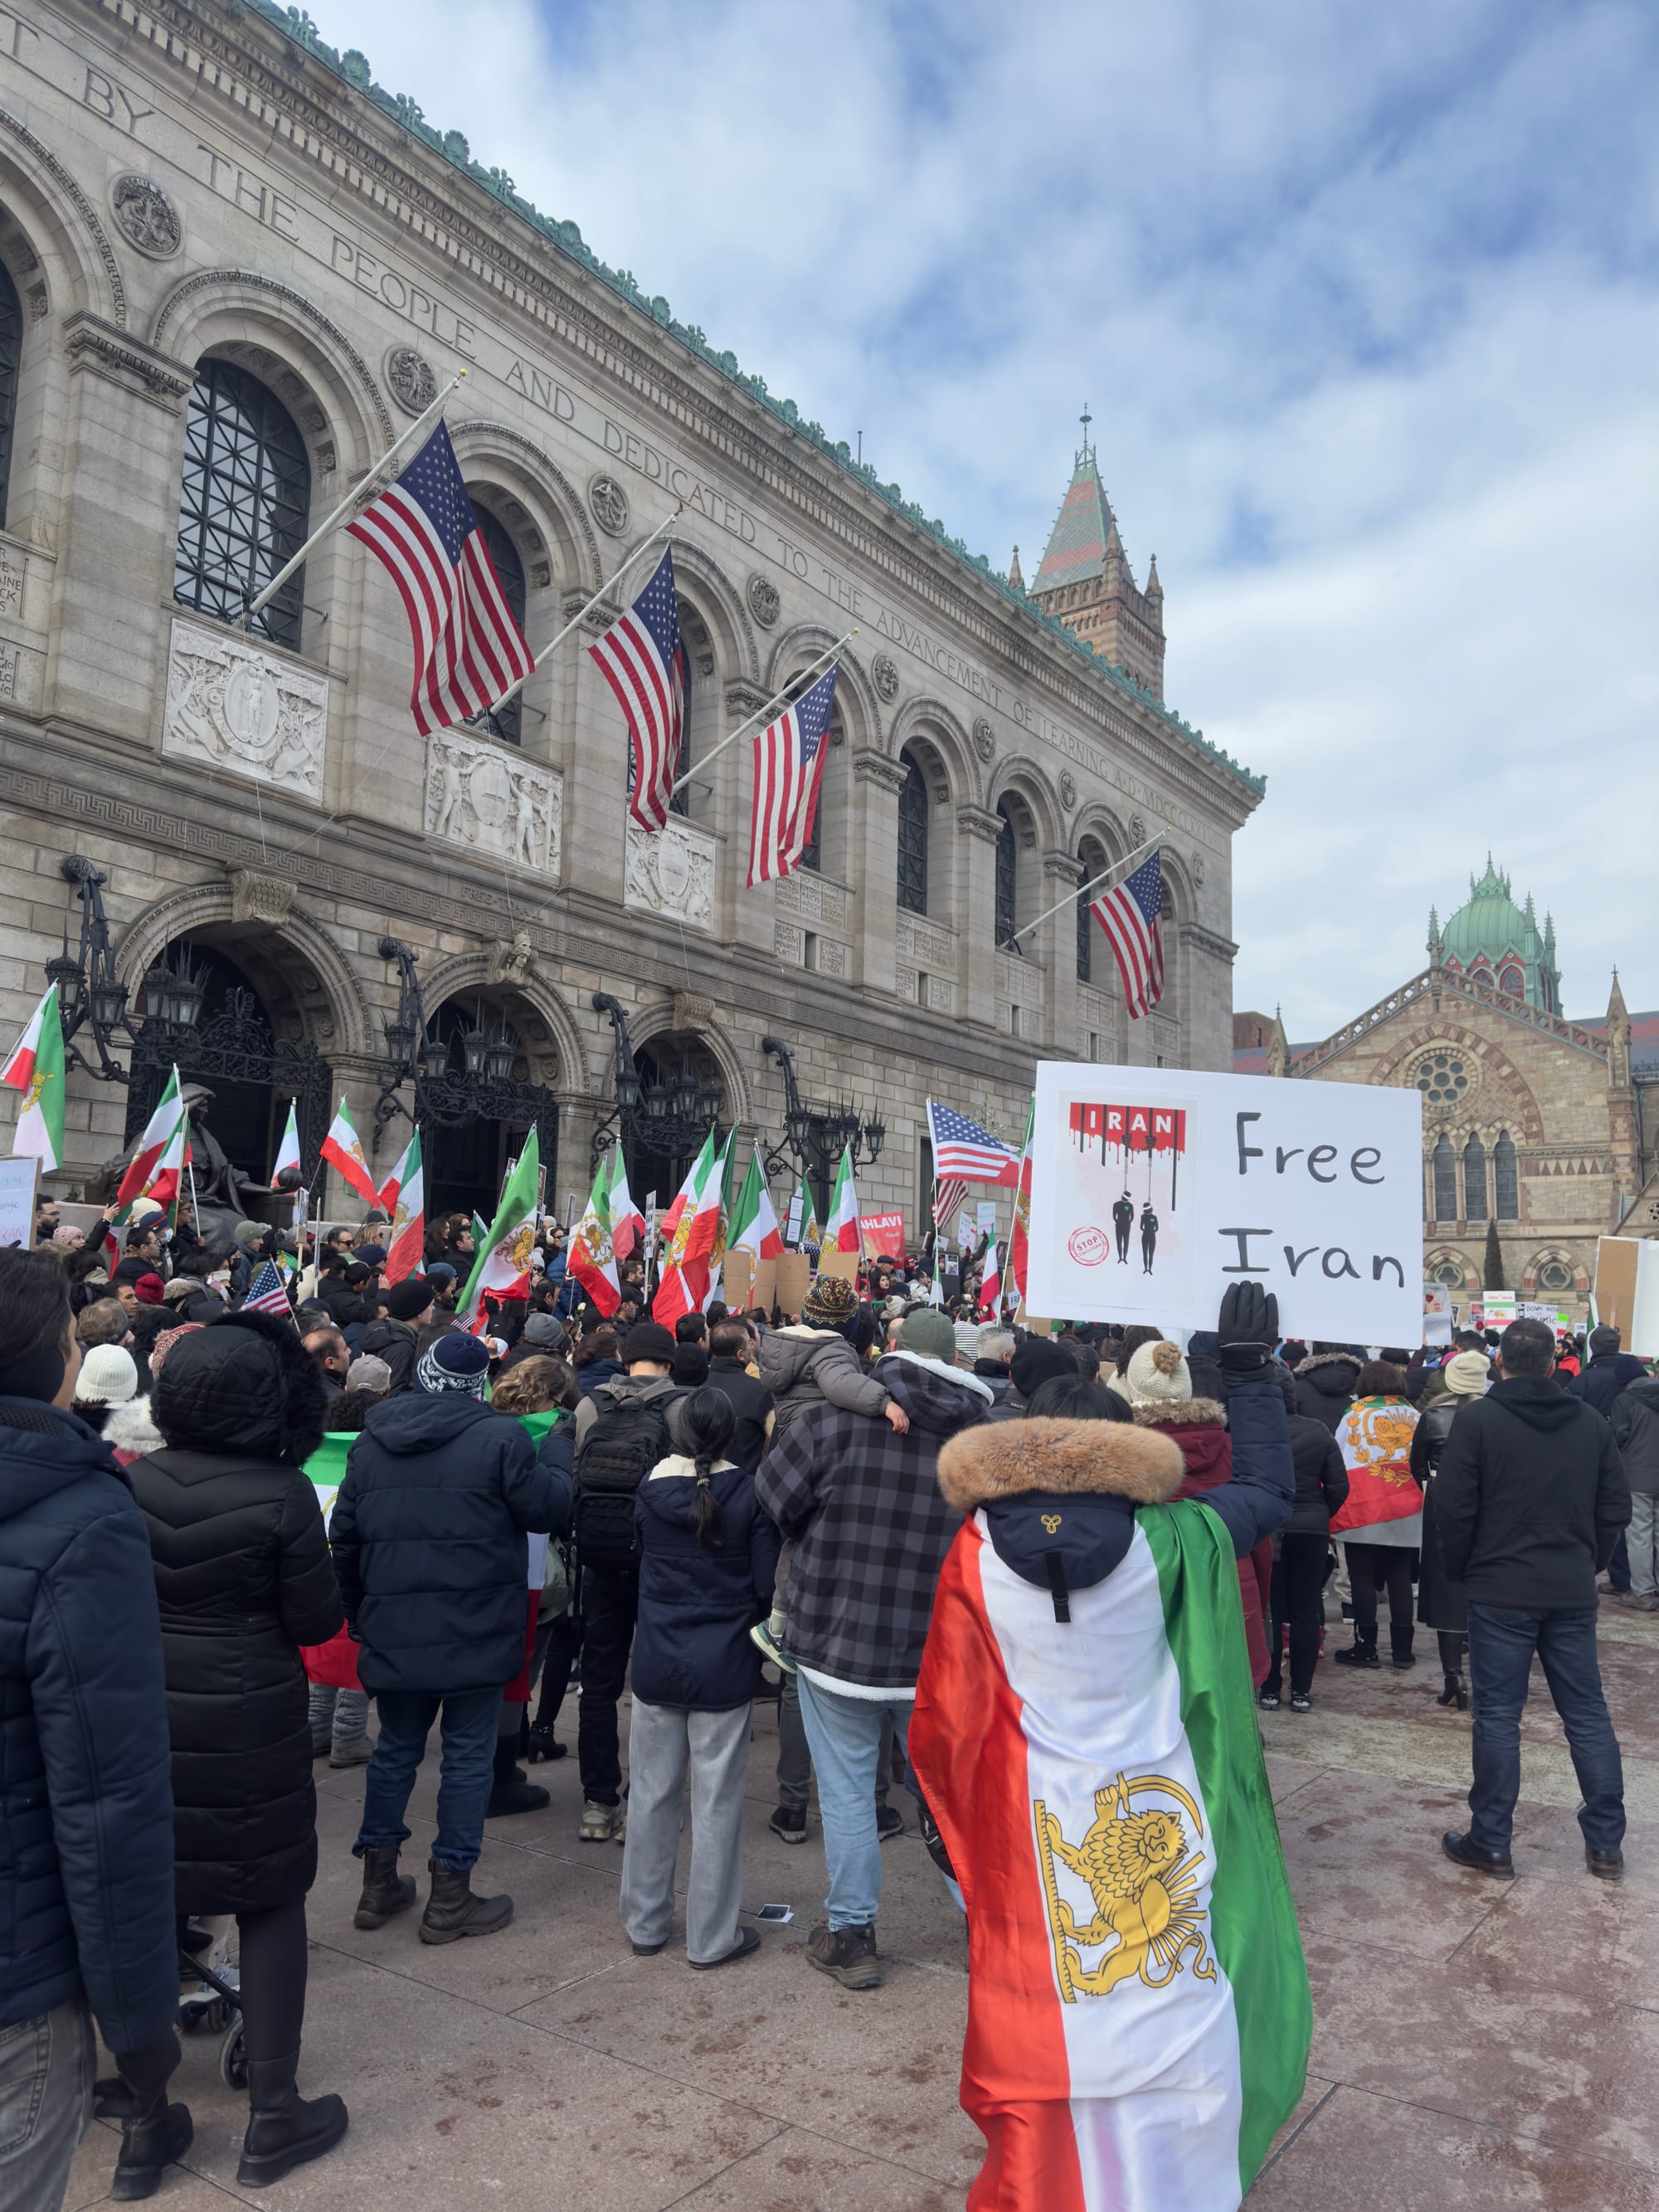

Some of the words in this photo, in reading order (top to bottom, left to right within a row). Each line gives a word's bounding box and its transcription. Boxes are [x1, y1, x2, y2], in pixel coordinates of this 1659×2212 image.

[83, 66, 156, 134] BY
[197, 143, 300, 243] THE
[332, 236, 478, 360] PEOPLE
[504, 360, 575, 421] AND
[603, 420, 756, 544] DEDICATED
[777, 537, 808, 577] TO
[822, 568, 864, 618] THE
[876, 599, 1002, 707] ADVANCEMENT
[1014, 702, 1034, 727] OF
[1044, 719, 1108, 779] LEARNING
[1089, 1110, 1173, 1134] IRAN
[1236, 1111, 1385, 1185] Free
[1077, 1236, 1098, 1252] STOP
[1218, 1228, 1404, 1288] Iran
